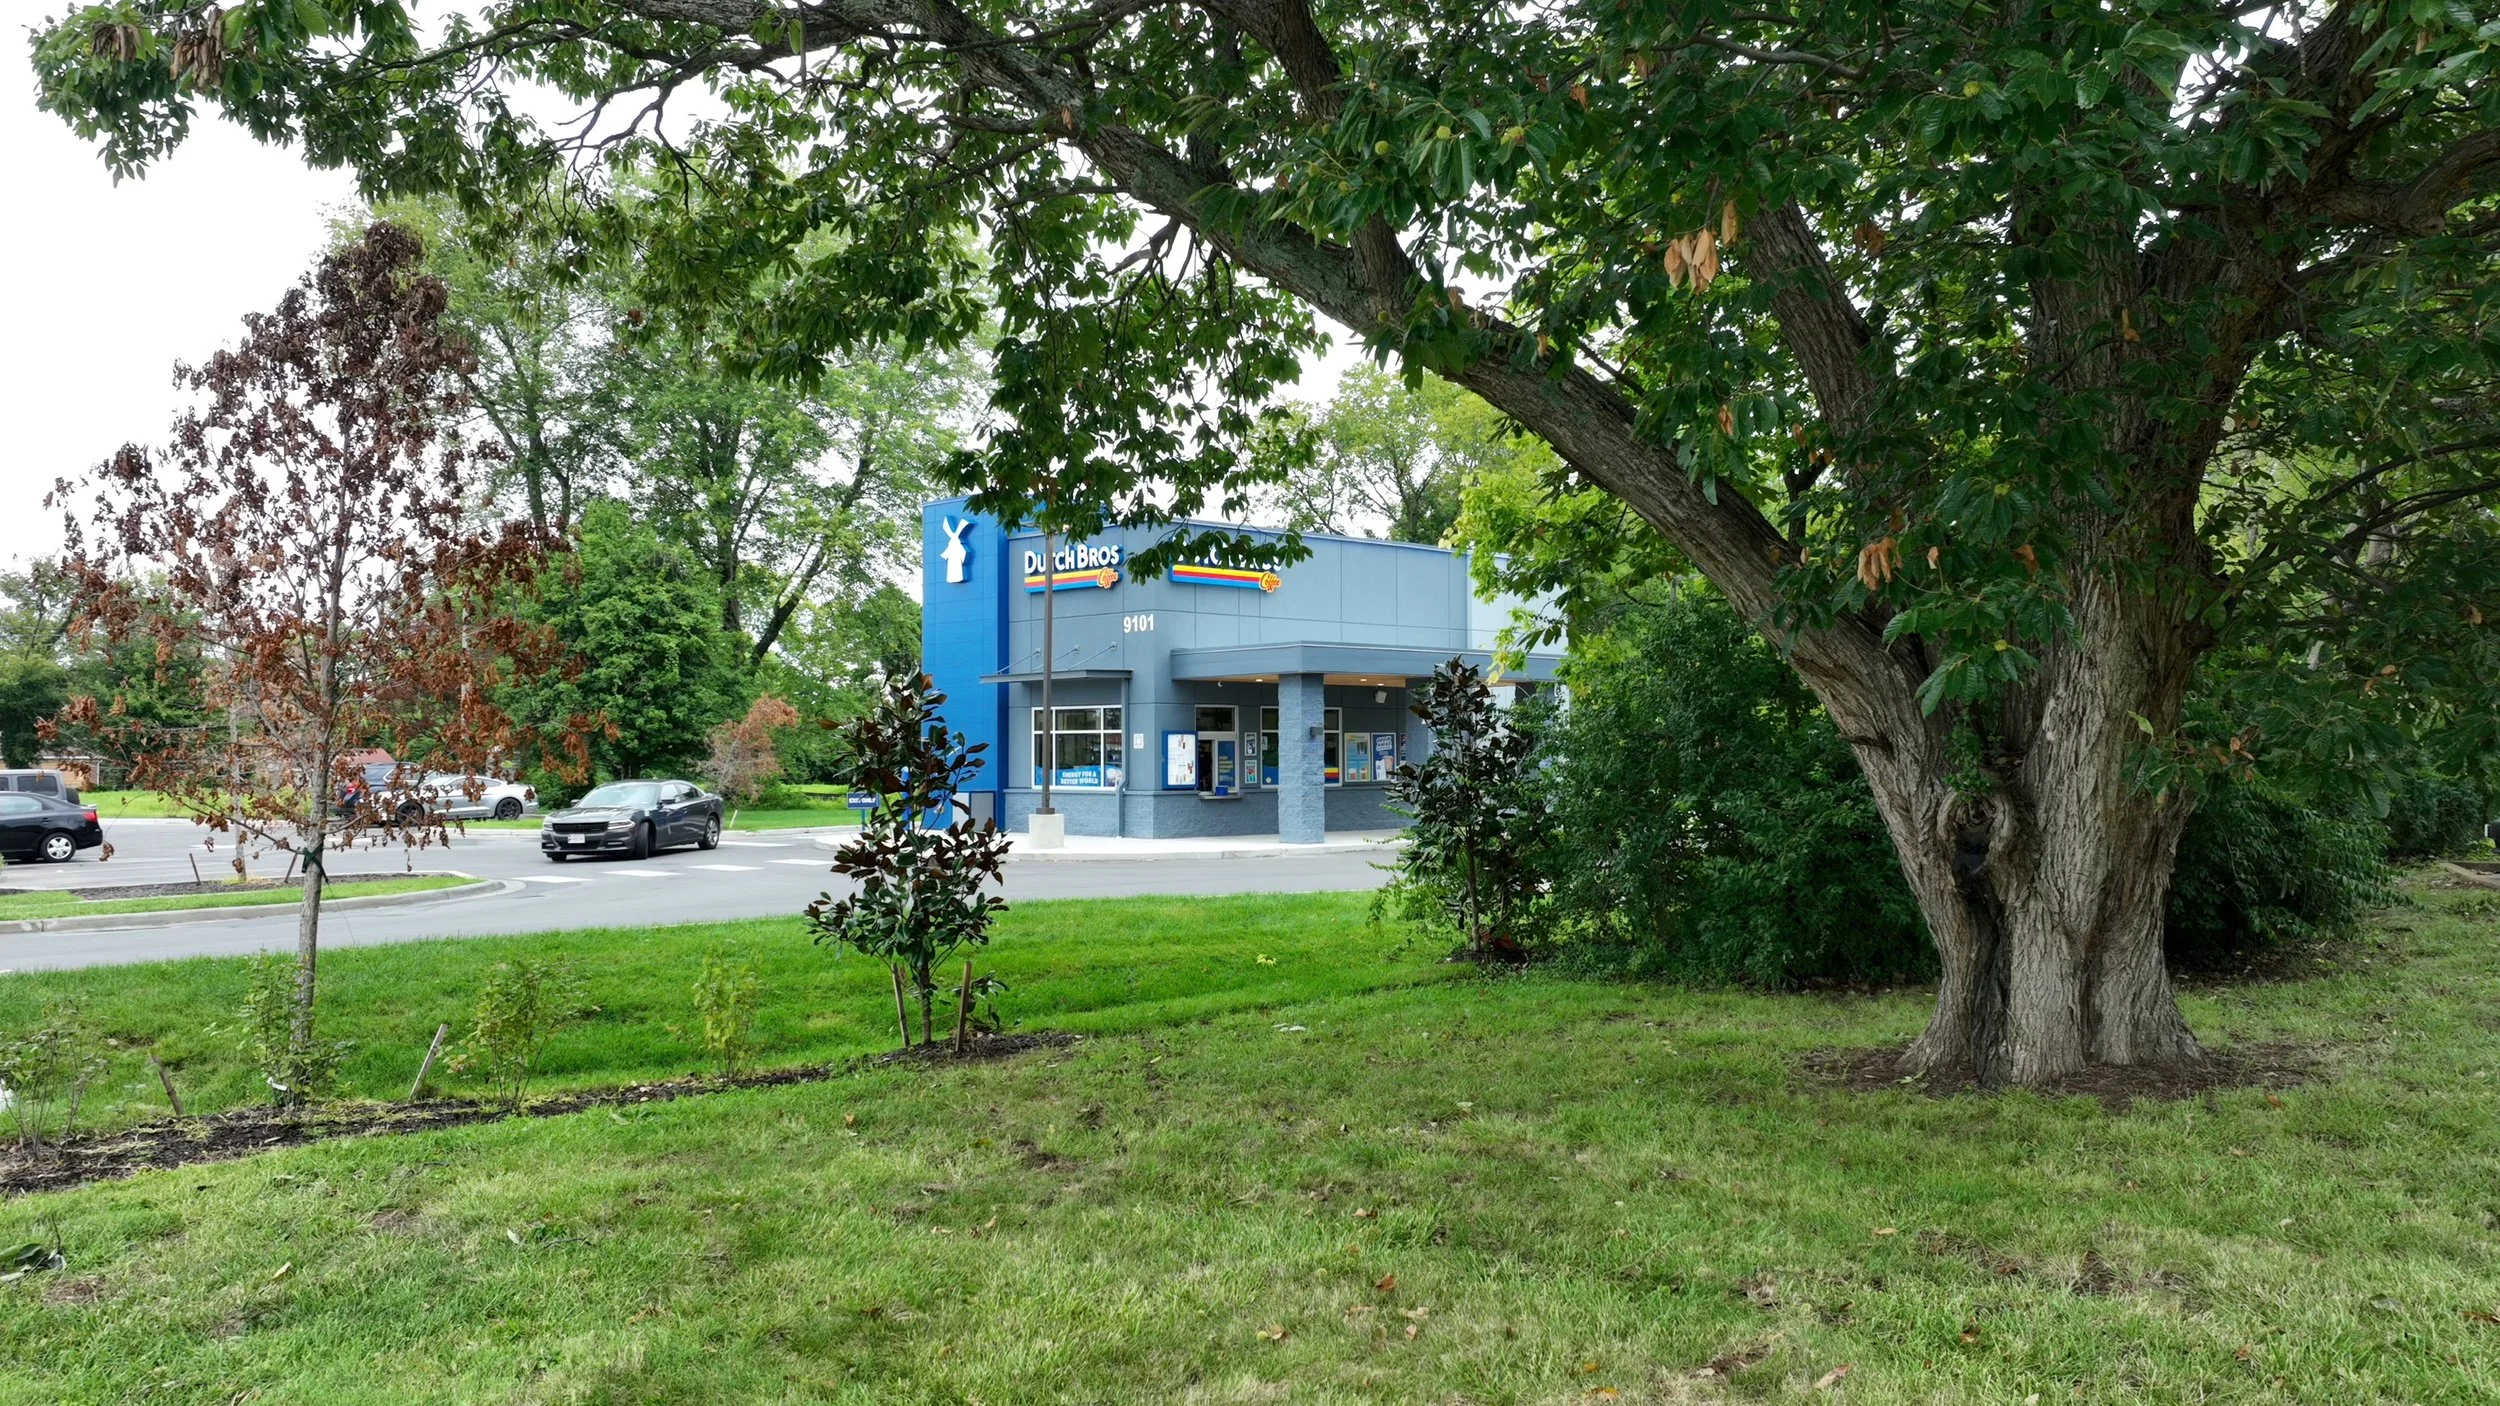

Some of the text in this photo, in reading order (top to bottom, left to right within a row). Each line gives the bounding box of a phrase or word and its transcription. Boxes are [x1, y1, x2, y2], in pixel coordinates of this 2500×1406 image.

[1024, 543, 1120, 574] DUCH BROS
[1260, 571, 1282, 592] Coffee
[1124, 613, 1153, 634] 9101
